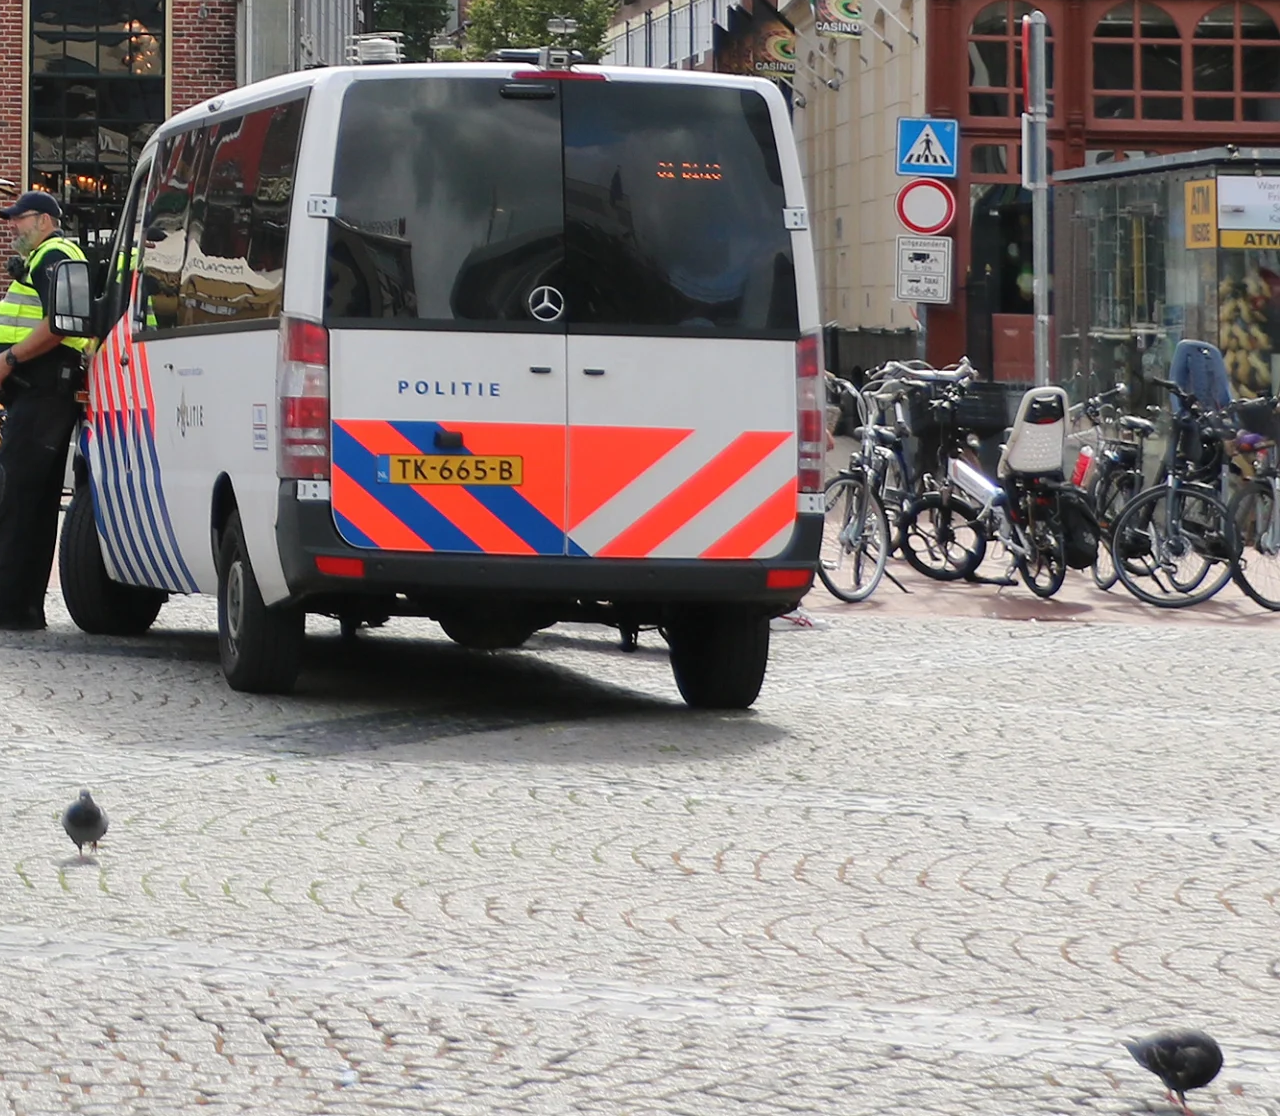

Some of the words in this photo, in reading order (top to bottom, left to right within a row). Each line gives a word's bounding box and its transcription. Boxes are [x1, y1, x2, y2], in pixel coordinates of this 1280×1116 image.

[815, 20, 860, 32] CASINO
[755, 61, 795, 72] CASINO
[397, 380, 501, 397] POLITIE
[397, 458, 513, 481] TK-665-B
